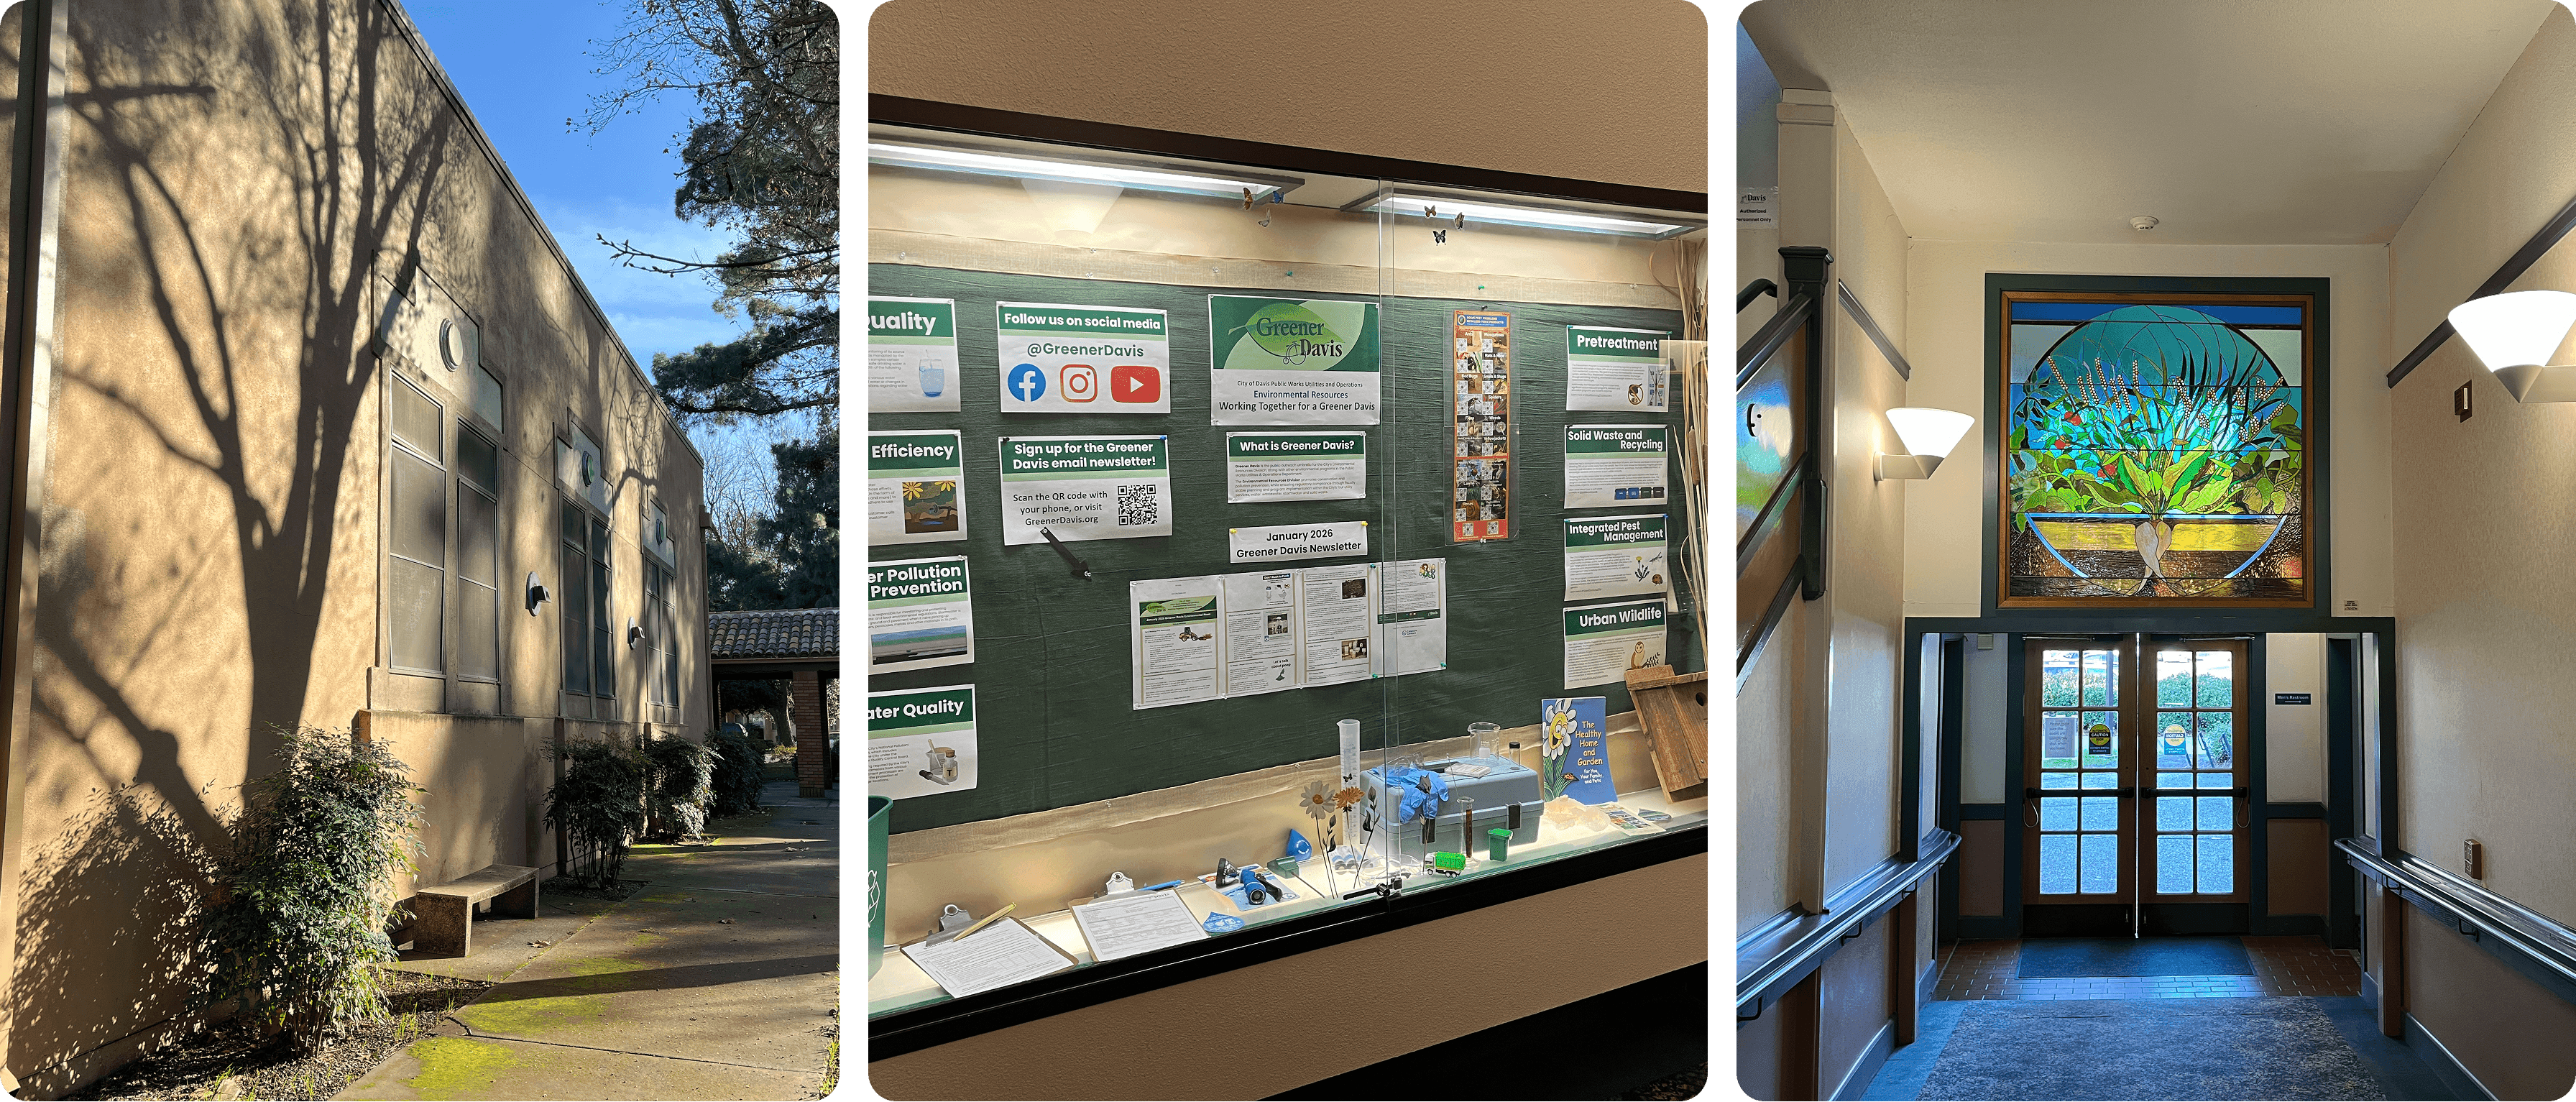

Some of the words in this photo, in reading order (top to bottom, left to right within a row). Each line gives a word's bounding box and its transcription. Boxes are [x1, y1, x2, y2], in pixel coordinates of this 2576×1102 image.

[868, 311, 937, 336] uality
[1004, 313, 1046, 325] Follow
[1049, 316, 1064, 326] us
[1067, 317, 1082, 326] on
[1084, 316, 1121, 328] social
[1123, 318, 1160, 329] media
[1256, 318, 1324, 336] Greener
[1027, 343, 1144, 357] @GreenerDavis
[1300, 339, 1343, 357] Davis
[1577, 335, 1657, 351] Pretreatment
[1219, 402, 1256, 411] Working
[1259, 402, 1295, 412] Together
[1568, 431, 1591, 440] Solid
[1593, 431, 1623, 440] Waste
[1624, 430, 1642, 440] and
[872, 444, 954, 460] Efficiency
[1015, 444, 1042, 457] Sign
[1046, 444, 1062, 456] up
[1064, 443, 1082, 453] for
[1084, 443, 1104, 453] the
[1107, 443, 1153, 453] Greener
[1240, 441, 1269, 451] What
[1271, 441, 1279, 451] is
[1282, 441, 1321, 451] Greener
[1323, 440, 1354, 450] Davis?
[1620, 439, 1663, 451] Recycling
[1013, 458, 1049, 469] Davis
[1052, 457, 1087, 468] email
[1090, 456, 1156, 467] newsletter!
[1020, 506, 1039, 515] your
[1042, 505, 1072, 515] phone,
[1025, 515, 1098, 526] GreenerDavis.org
[1266, 531, 1308, 542] January
[1310, 529, 1333, 538] 2026
[1570, 521, 1620, 536] Integrated
[1622, 521, 1640, 531] Pest
[1604, 529, 1663, 542] Management
[1237, 548, 1277, 558] Greener
[1280, 544, 1307, 555] Davis
[1310, 542, 1361, 553] Newsletter
[887, 564, 962, 582] Pollution
[870, 579, 963, 598] Prevention
[1580, 614, 1617, 627] Urban
[1619, 607, 1662, 623] Wildlife
[903, 699, 965, 717] Quality
[1576, 730, 1602, 739] Healthy
[1578, 758, 1603, 766] Garden
